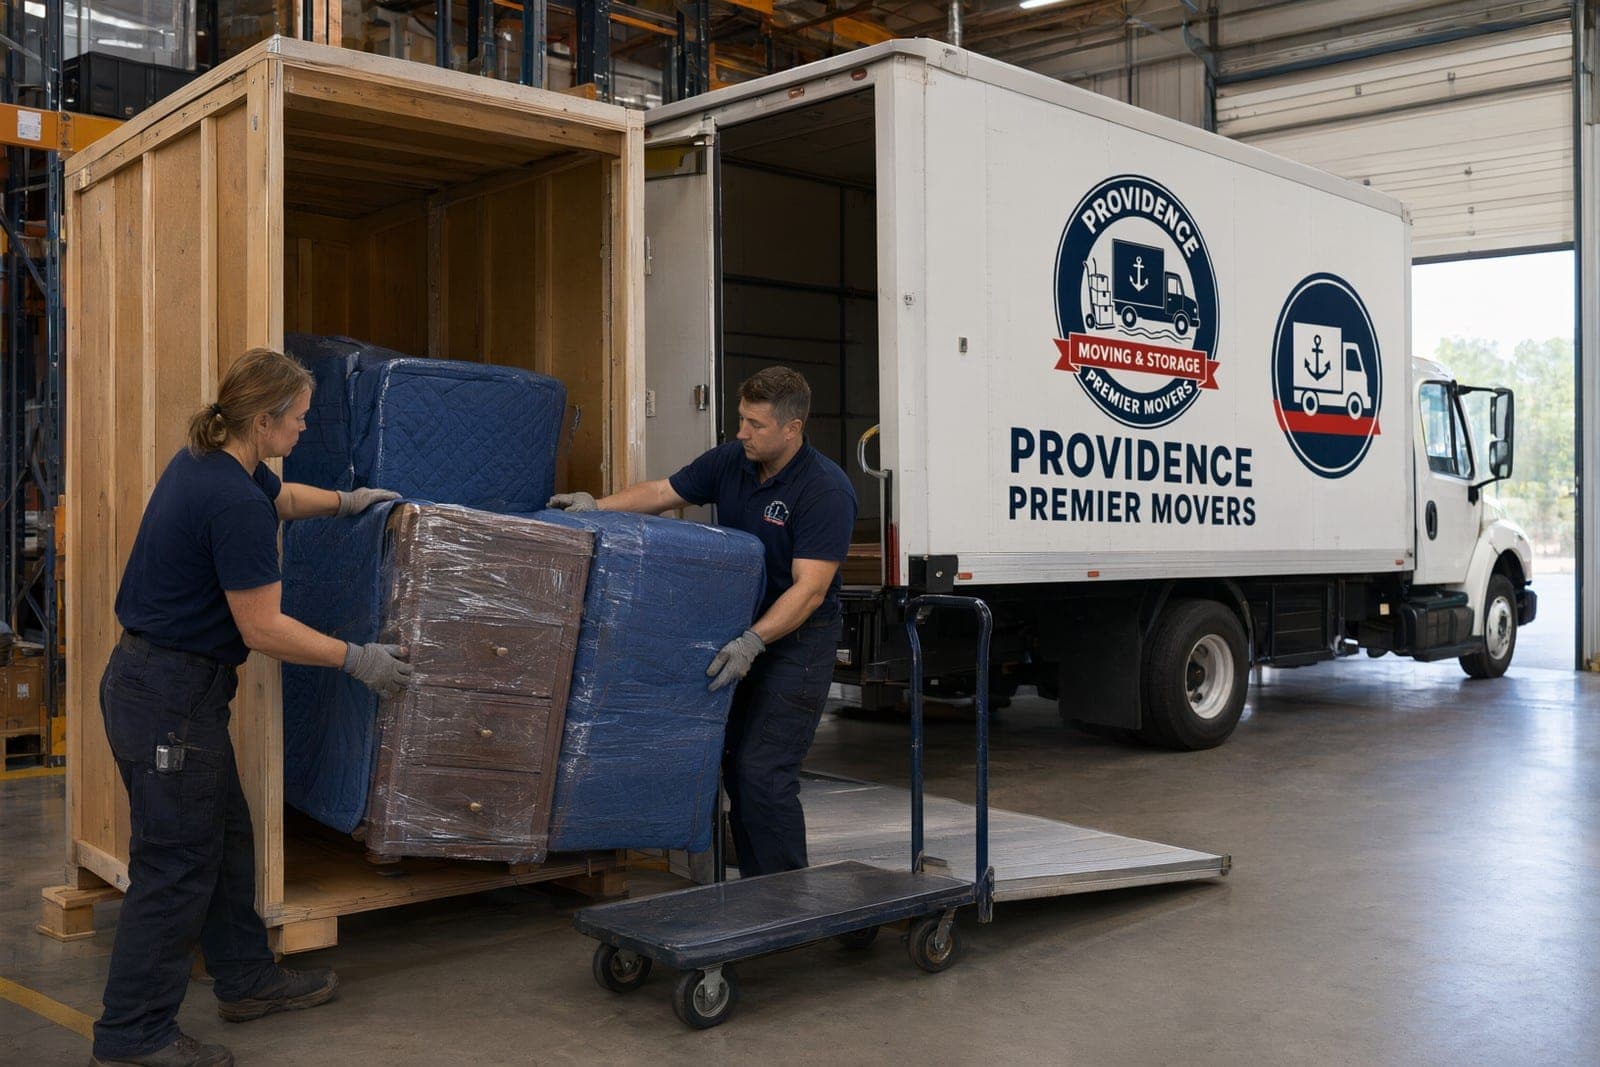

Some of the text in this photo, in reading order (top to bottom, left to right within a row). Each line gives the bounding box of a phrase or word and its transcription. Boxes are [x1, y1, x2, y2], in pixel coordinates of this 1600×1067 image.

[1081, 187, 1199, 258] PROVIDENCE
[1078, 342, 1200, 374] MOVING & STORAGE
[1085, 370, 1193, 415] PREMIER MOVERS
[1010, 427, 1253, 488] PROVIDENCE
[1008, 485, 1256, 526] PREMIER MOVERS
